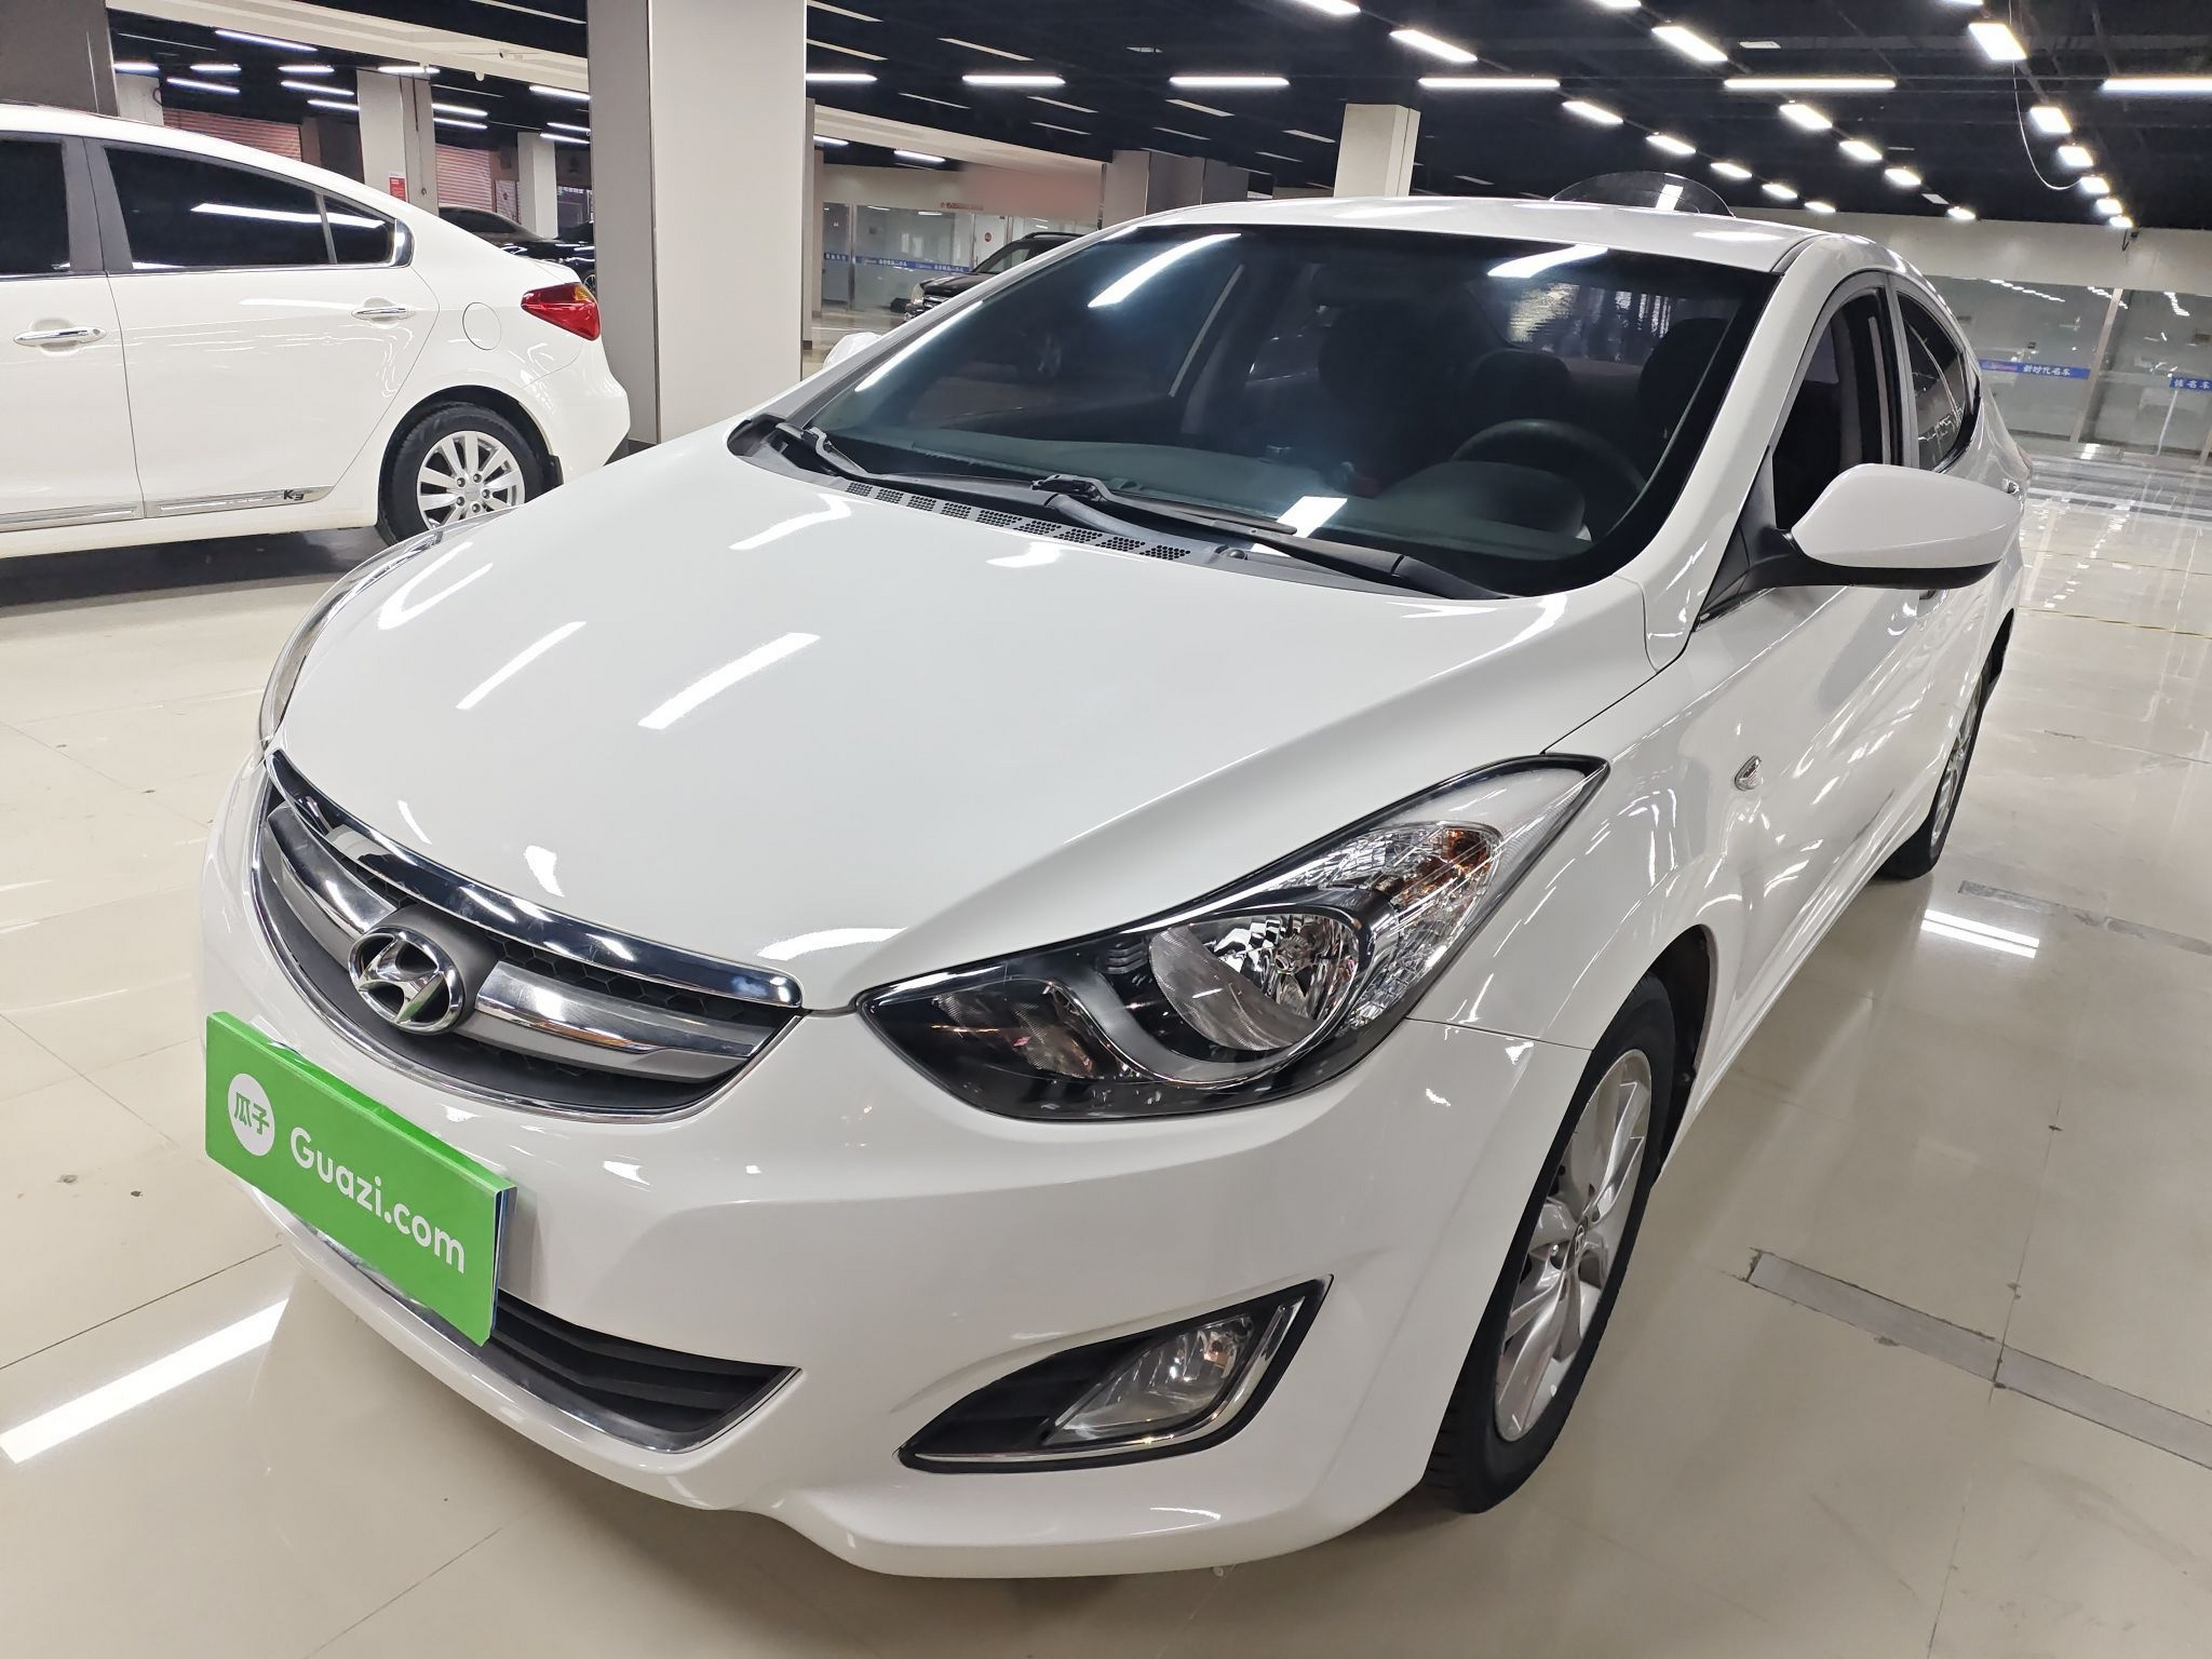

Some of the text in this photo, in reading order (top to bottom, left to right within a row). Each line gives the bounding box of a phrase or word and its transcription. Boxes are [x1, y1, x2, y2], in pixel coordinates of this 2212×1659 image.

[284, 490, 304, 501] K3
[234, 1092, 270, 1135] 瓜子
[290, 1127, 465, 1274] Guazi.com
